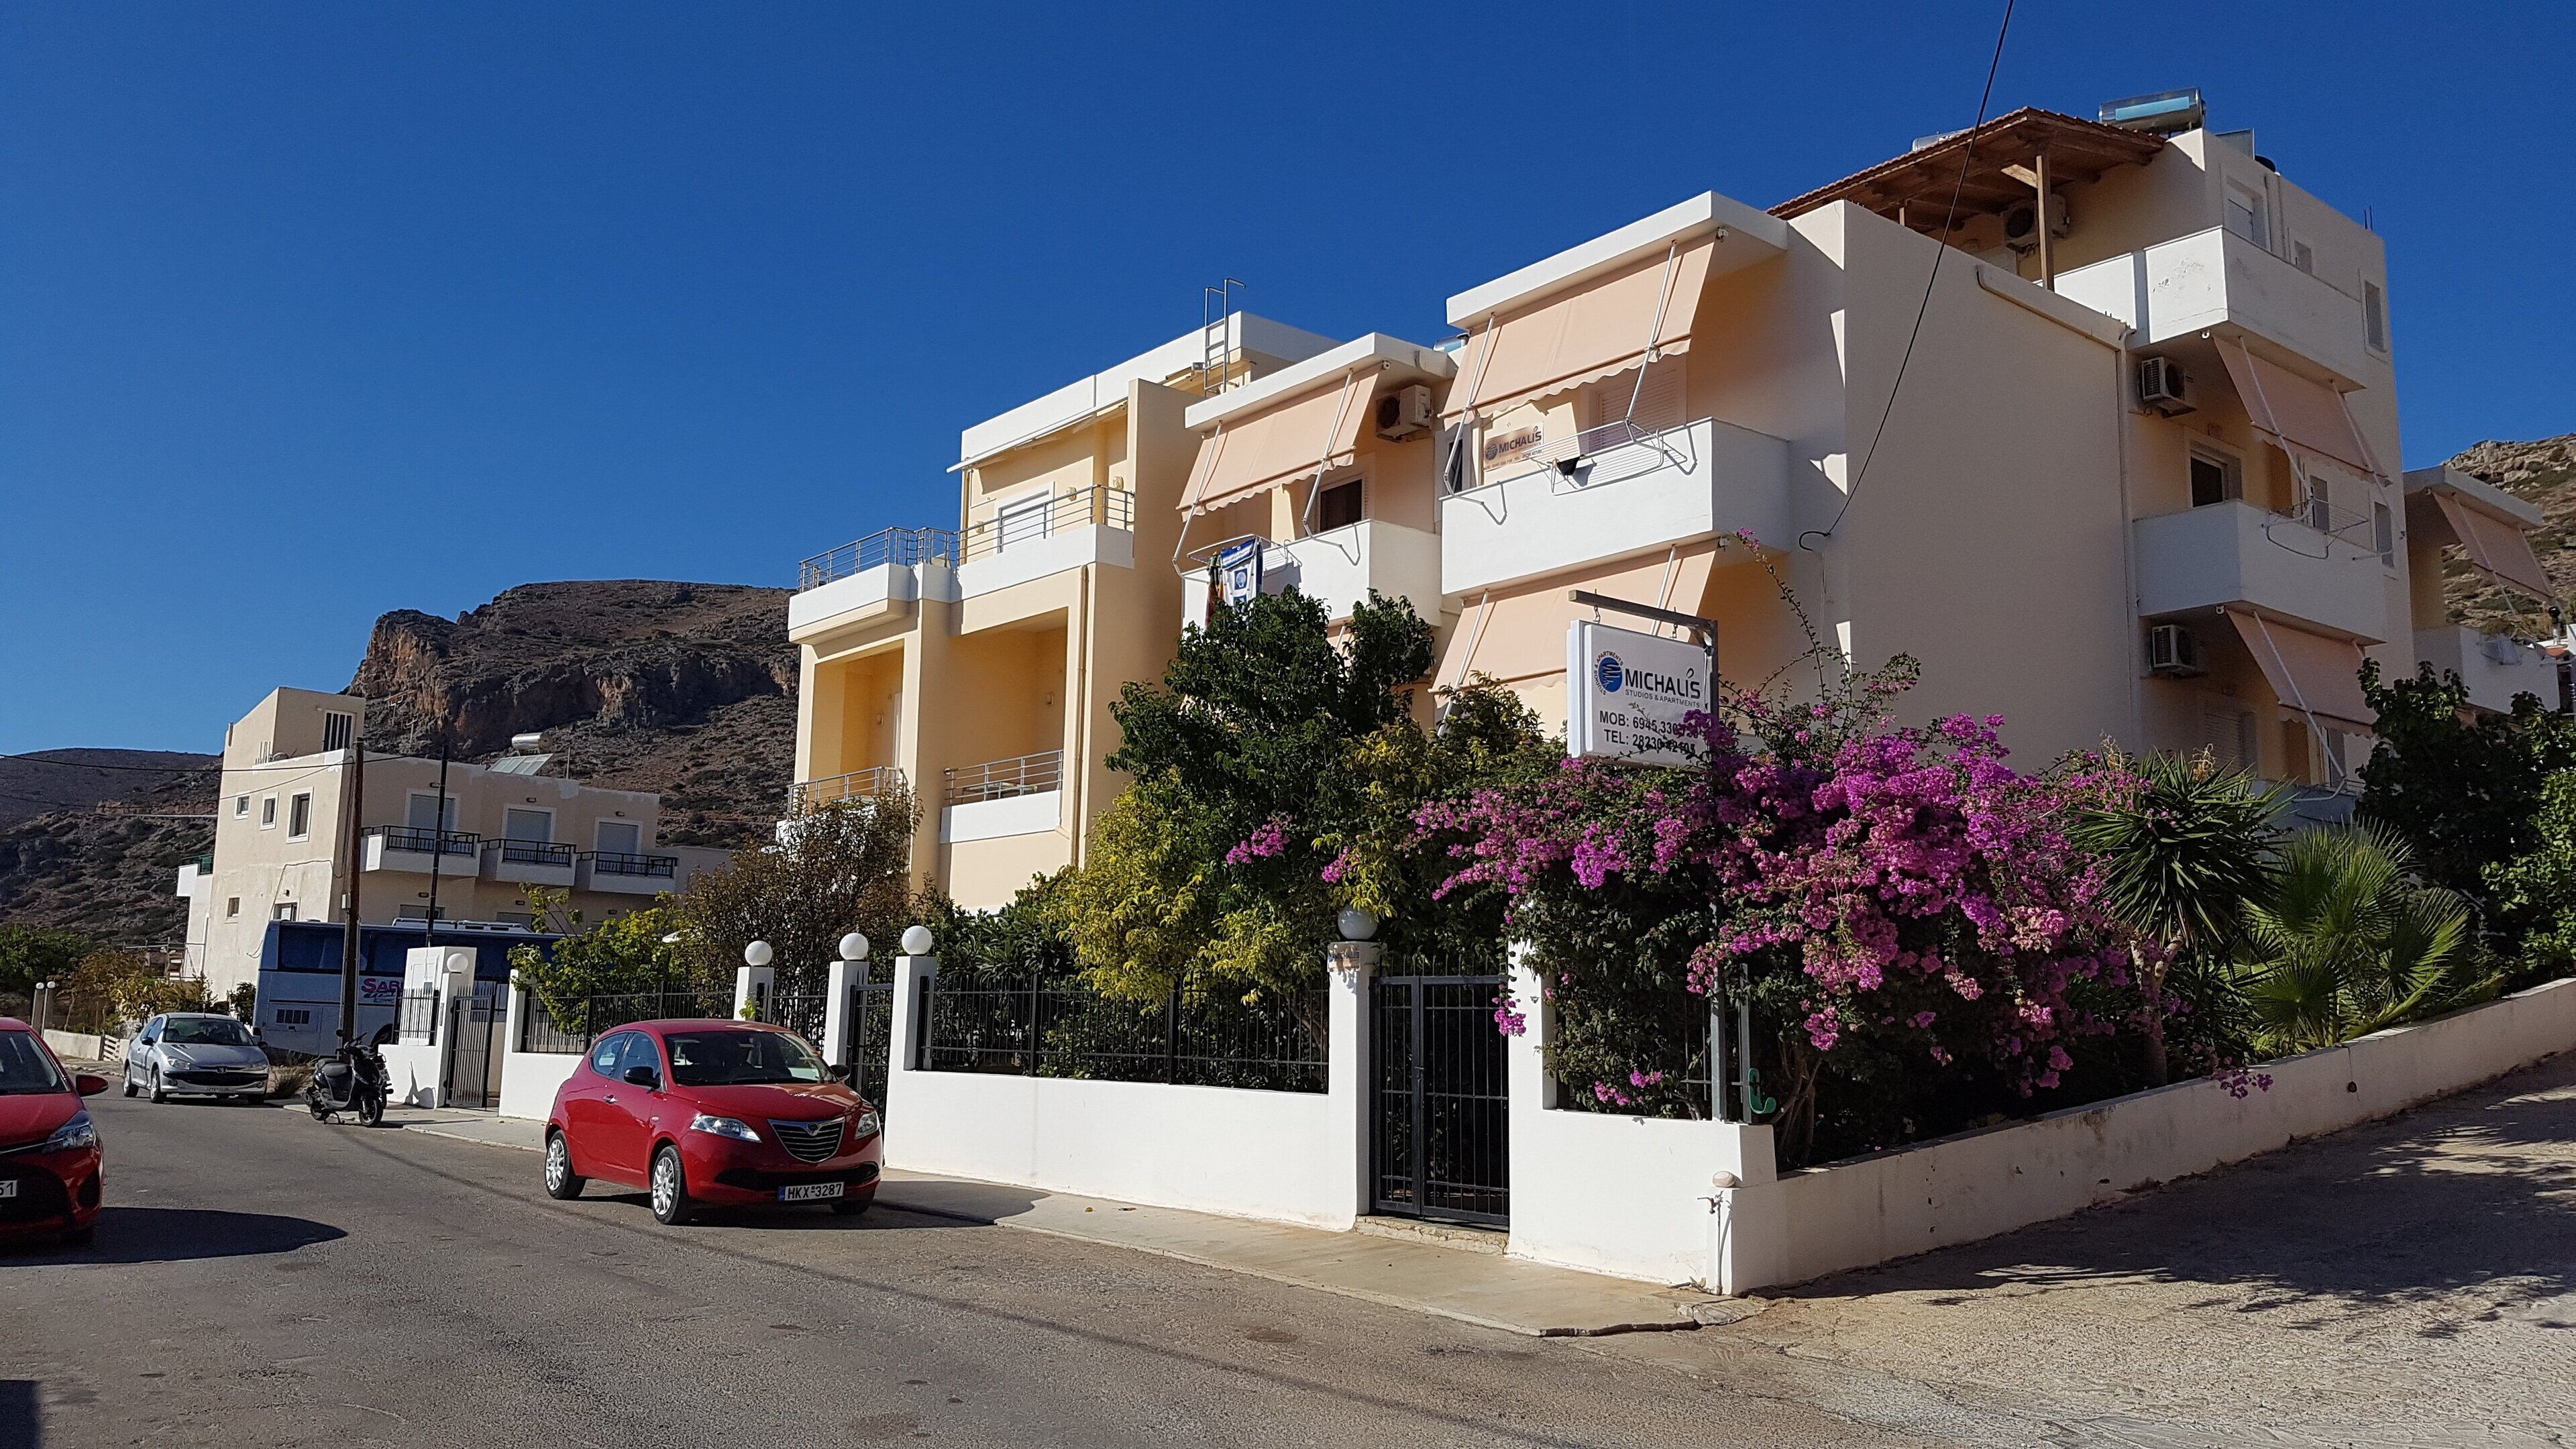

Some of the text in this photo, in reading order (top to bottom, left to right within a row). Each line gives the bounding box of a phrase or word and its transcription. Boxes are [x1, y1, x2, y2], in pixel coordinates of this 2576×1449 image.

[1625, 689, 1653, 700] STUDIOS
[1660, 696, 1701, 708] APARTMENTS
[1599, 710, 1629, 727] MOB:
[1604, 729, 1629, 745] TEL:
